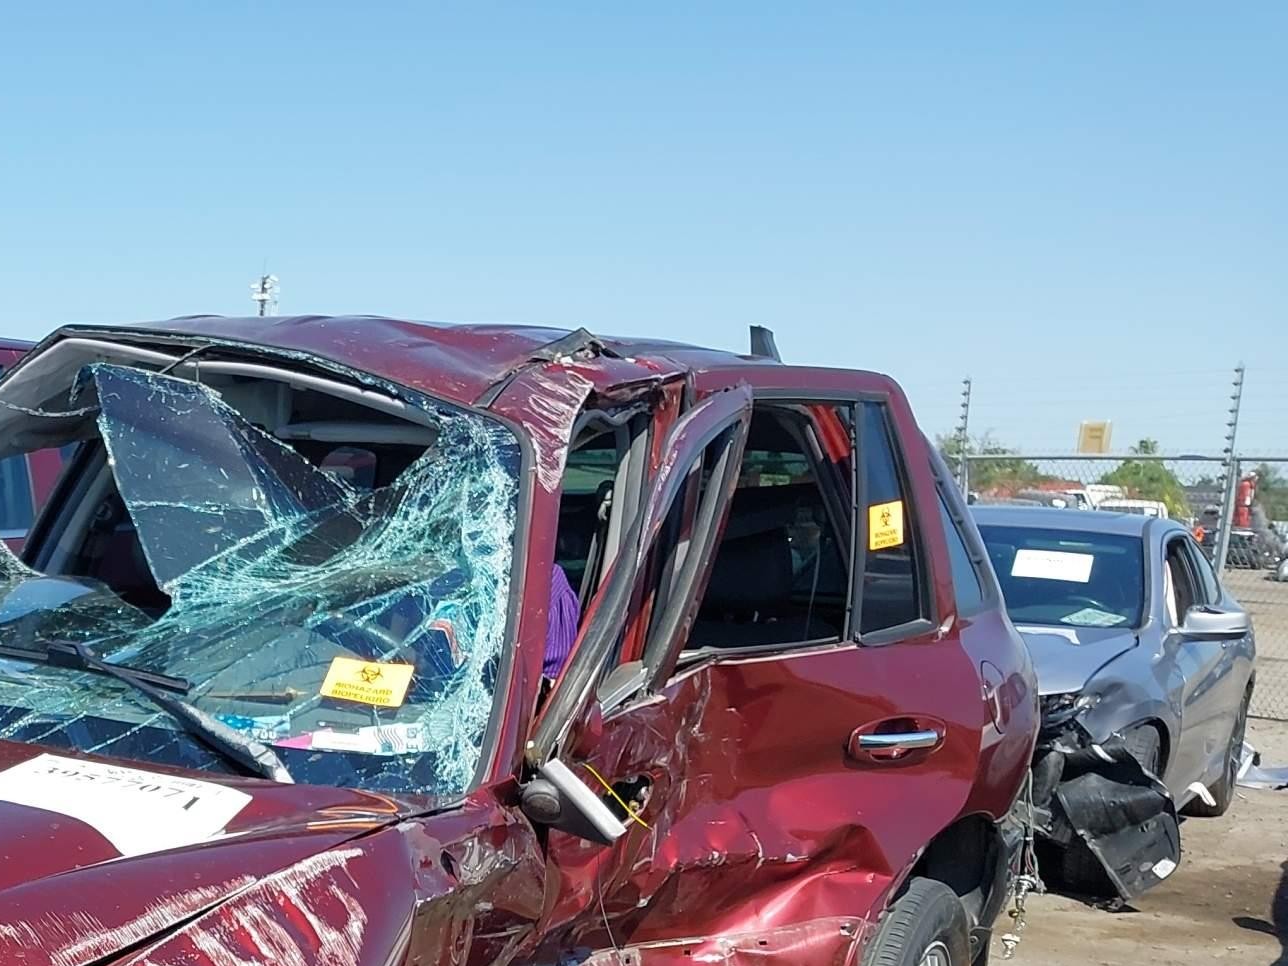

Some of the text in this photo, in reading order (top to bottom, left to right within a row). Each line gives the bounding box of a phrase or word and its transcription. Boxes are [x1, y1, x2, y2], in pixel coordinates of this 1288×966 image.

[330, 688, 391, 705] BIOPELIGRO
[334, 681, 393, 697] BIOHAZARD
[34, 766, 201, 811] 39577071
